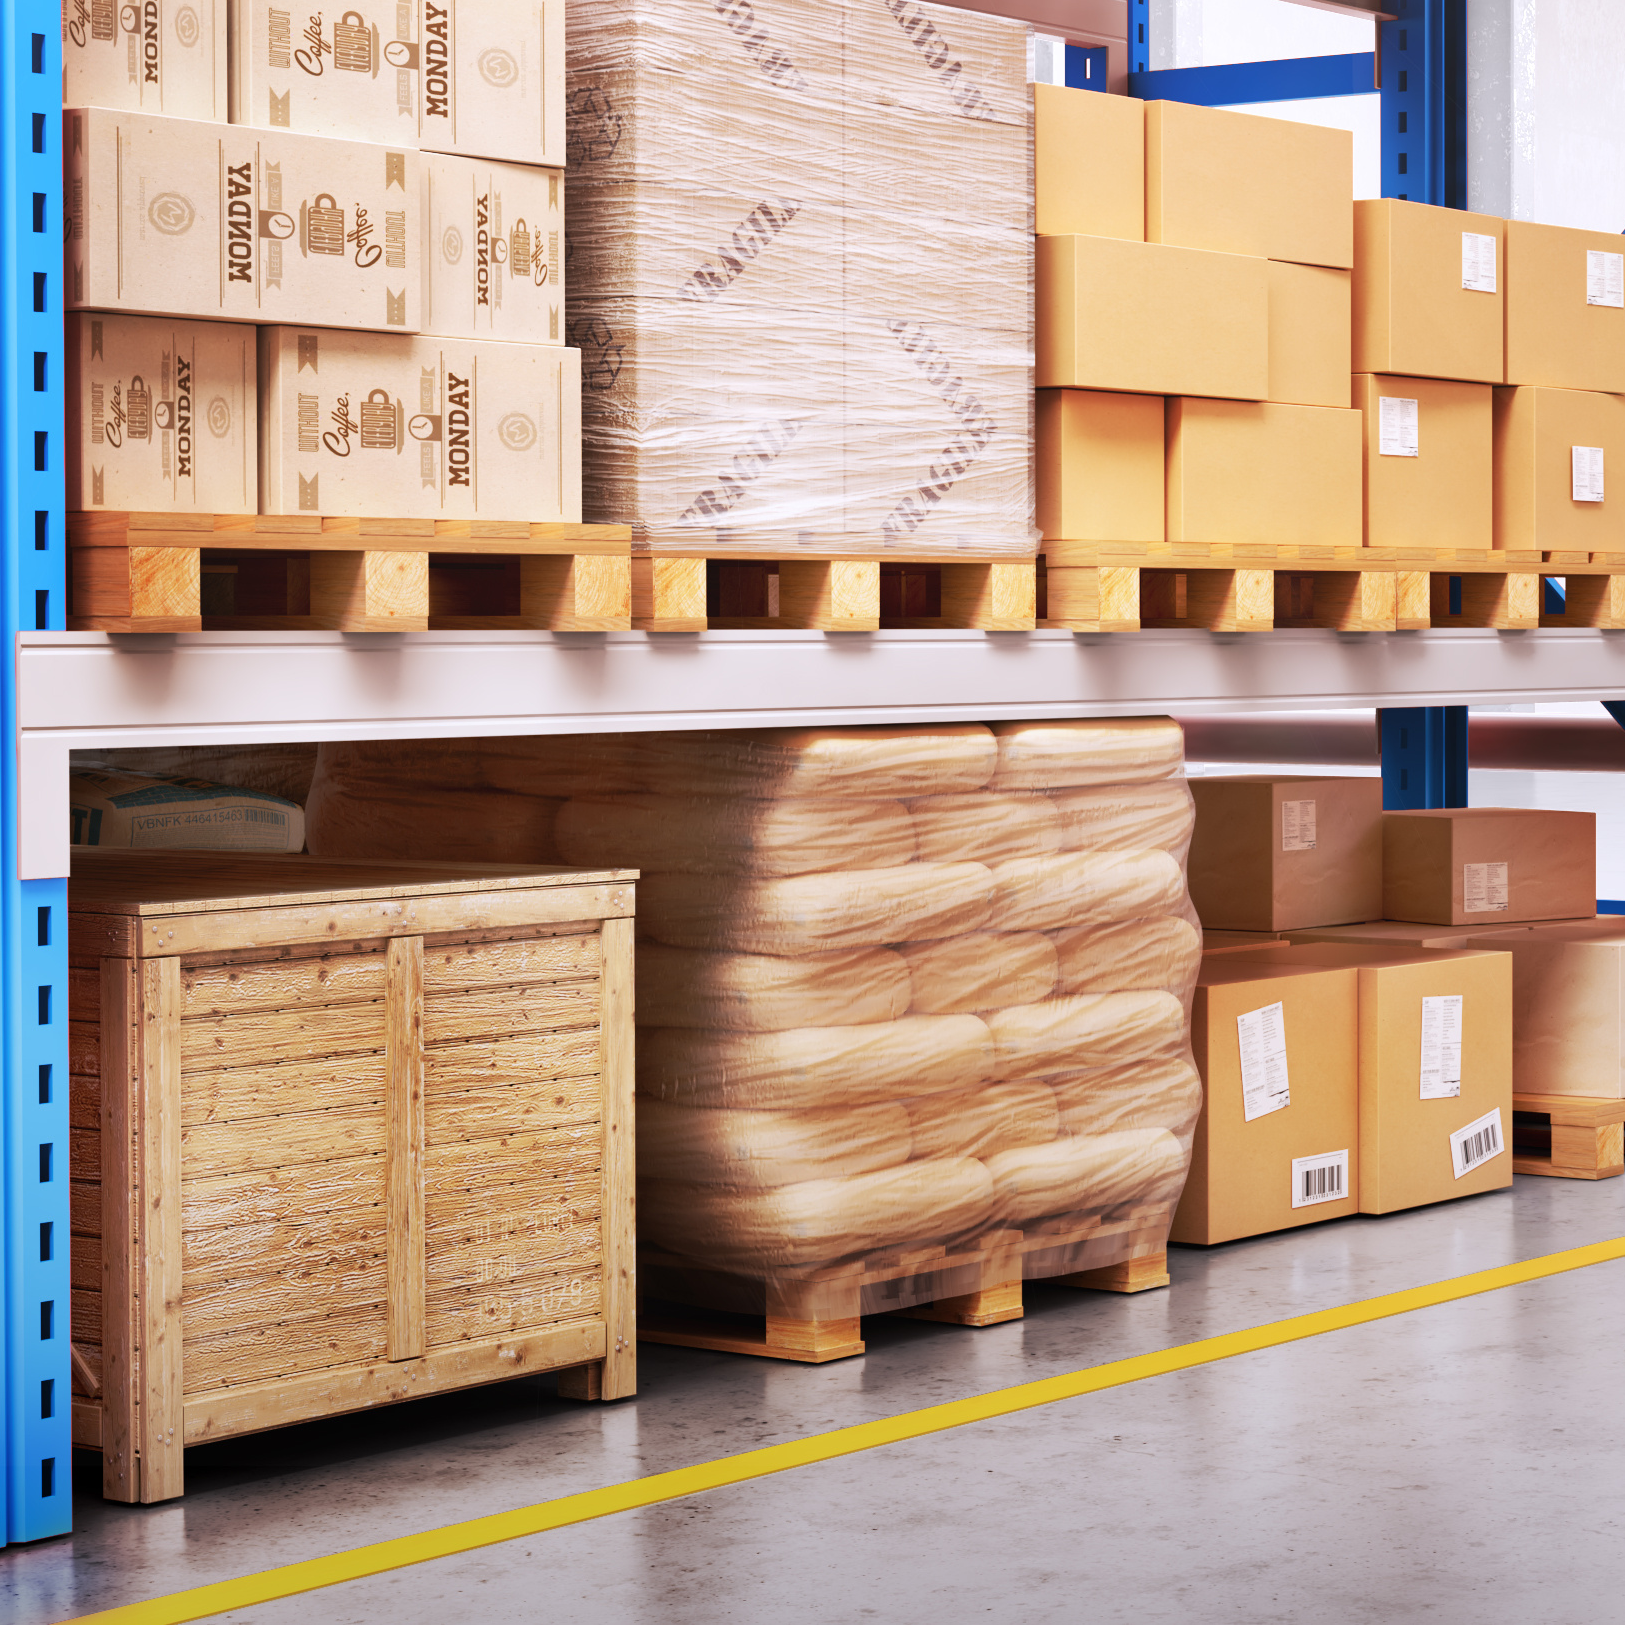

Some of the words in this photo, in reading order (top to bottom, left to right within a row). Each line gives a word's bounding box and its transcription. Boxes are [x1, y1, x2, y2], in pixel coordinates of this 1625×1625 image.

[269, 7, 290, 68] WITHOUT
[426, 1, 448, 118] MONDAY
[178, 355, 191, 477] MONDAY
[298, 393, 319, 452] WITHOUT
[448, 373, 469, 486] MONDAY
